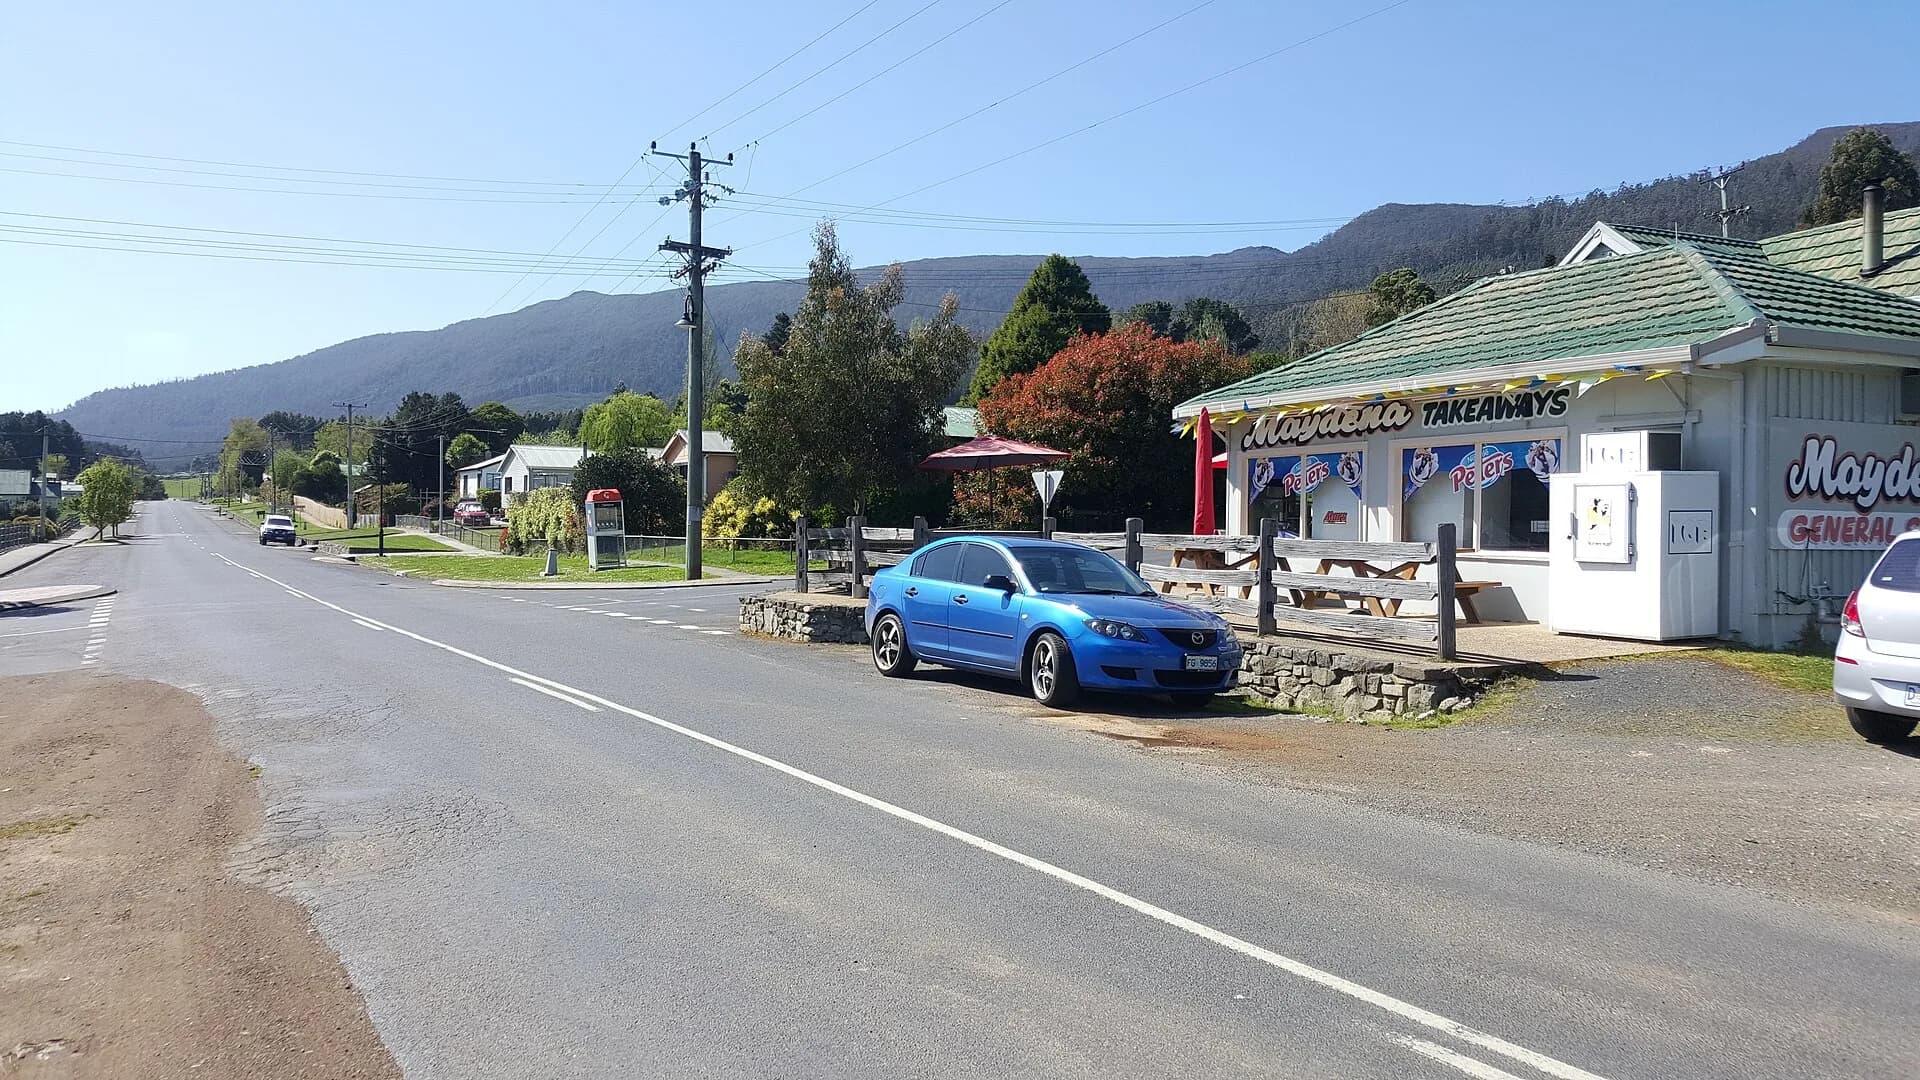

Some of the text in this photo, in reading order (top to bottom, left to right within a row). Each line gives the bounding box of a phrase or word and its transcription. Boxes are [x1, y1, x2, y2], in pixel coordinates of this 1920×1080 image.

[1241, 388, 1570, 450] Maydena TAKEAWAYS
[1790, 514, 1897, 543] GENERAL
